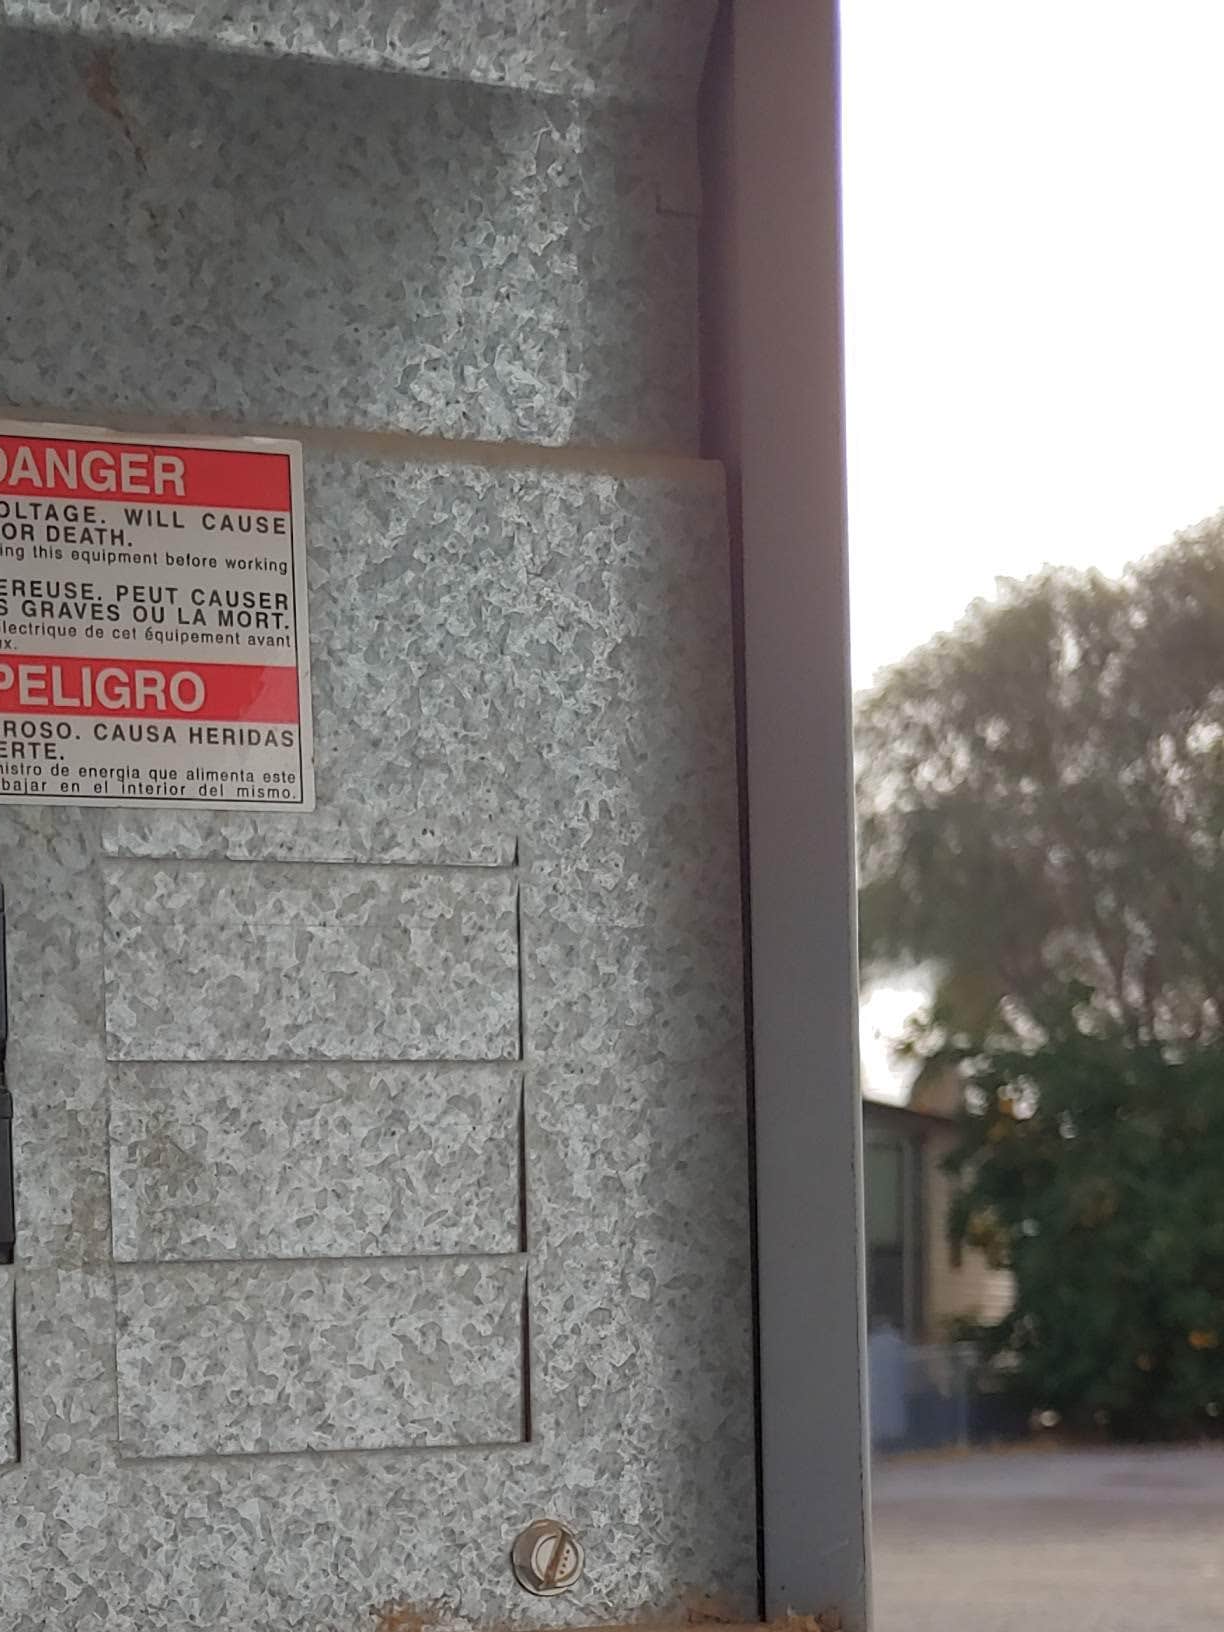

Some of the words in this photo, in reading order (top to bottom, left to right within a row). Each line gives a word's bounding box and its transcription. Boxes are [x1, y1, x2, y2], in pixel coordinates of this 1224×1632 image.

[124, 508, 185, 529] WILL
[202, 513, 286, 535] CAUSE
[1, 522, 35, 542] OR
[46, 525, 133, 547] DEATH.
[33, 545, 63, 560] this
[71, 549, 158, 566] equipment
[166, 552, 217, 568] before
[225, 557, 288, 575] working
[116, 584, 178, 604] PEUT
[191, 588, 289, 611] CAUSER
[22, 600, 120, 622] GRAVES
[133, 605, 165, 623] OU
[178, 608, 206, 626] LA
[218, 610, 290, 630] MORT.
[85, 625, 104, 640] de
[112, 628, 136, 640] cet
[145, 627, 240, 645] équipement
[247, 634, 291, 648] avant
[94, 722, 176, 743] CAUSA
[189, 727, 294, 747] HERIDAS
[51, 763, 70, 777] de
[149, 769, 176, 783] que
[186, 767, 254, 783] alimenta
[263, 770, 296, 784] este
[61, 782, 80, 793] en
[94, 781, 108, 794] el
[122, 781, 186, 796] interior
[199, 784, 224, 797] del
[237, 786, 296, 800] mismo.
